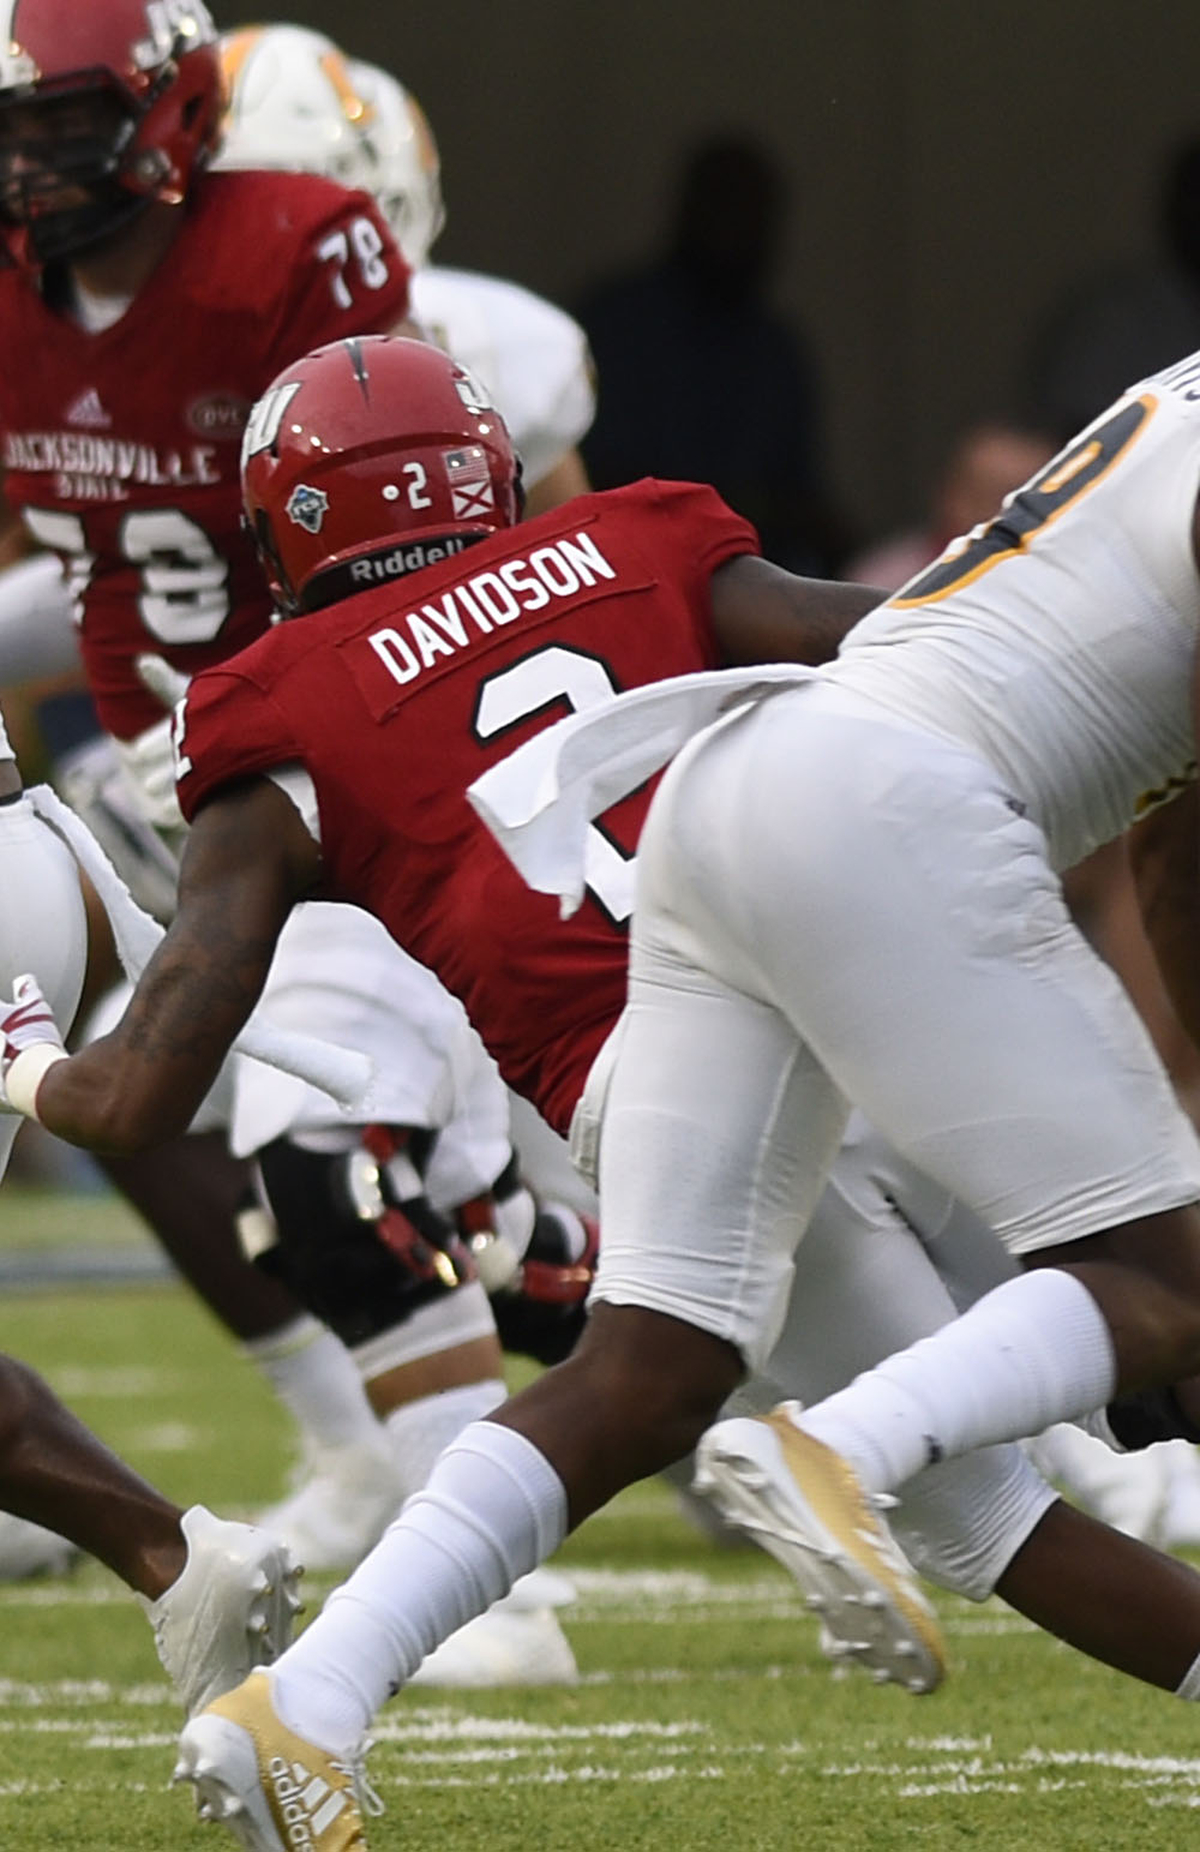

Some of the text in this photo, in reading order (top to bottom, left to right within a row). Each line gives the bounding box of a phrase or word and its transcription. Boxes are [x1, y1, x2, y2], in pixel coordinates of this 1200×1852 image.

[317, 216, 390, 311] 78
[402, 462, 432, 510] 2
[22, 506, 232, 645] 78
[351, 538, 465, 581] Riddell
[368, 532, 616, 685] DAVIDSON
